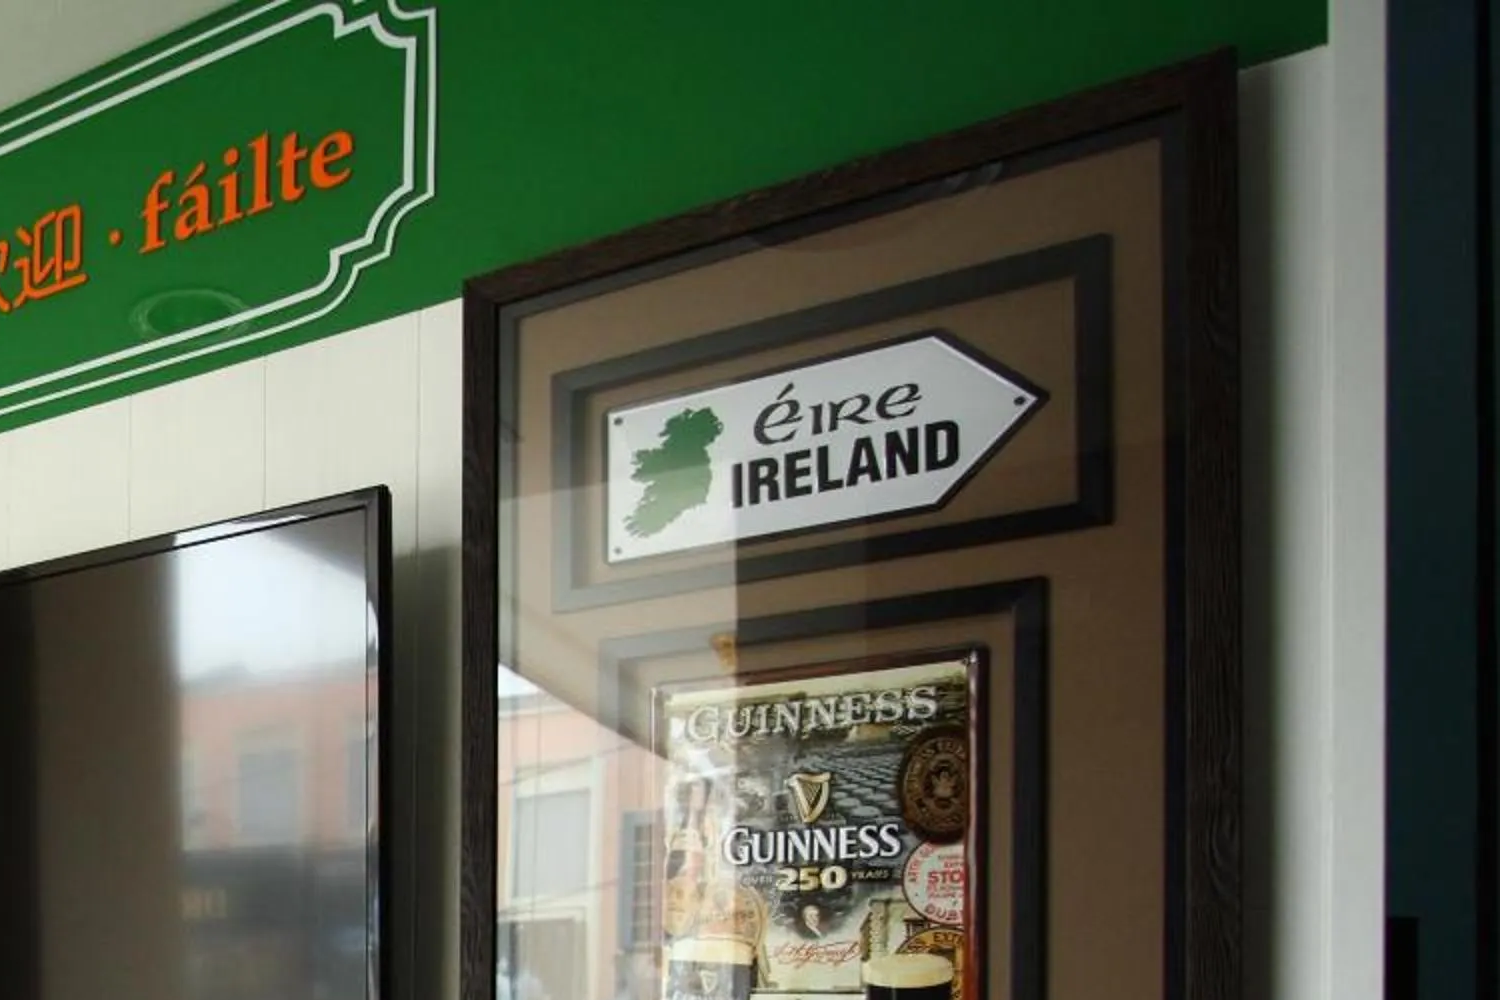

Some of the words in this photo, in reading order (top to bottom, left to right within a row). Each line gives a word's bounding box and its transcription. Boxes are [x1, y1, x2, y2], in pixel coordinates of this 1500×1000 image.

[141, 130, 355, 254] fáilte
[731, 419, 962, 508] IRELAND
[688, 686, 938, 742] GUINNESS
[724, 824, 901, 864] GUINNESS
[776, 864, 848, 891] 250
